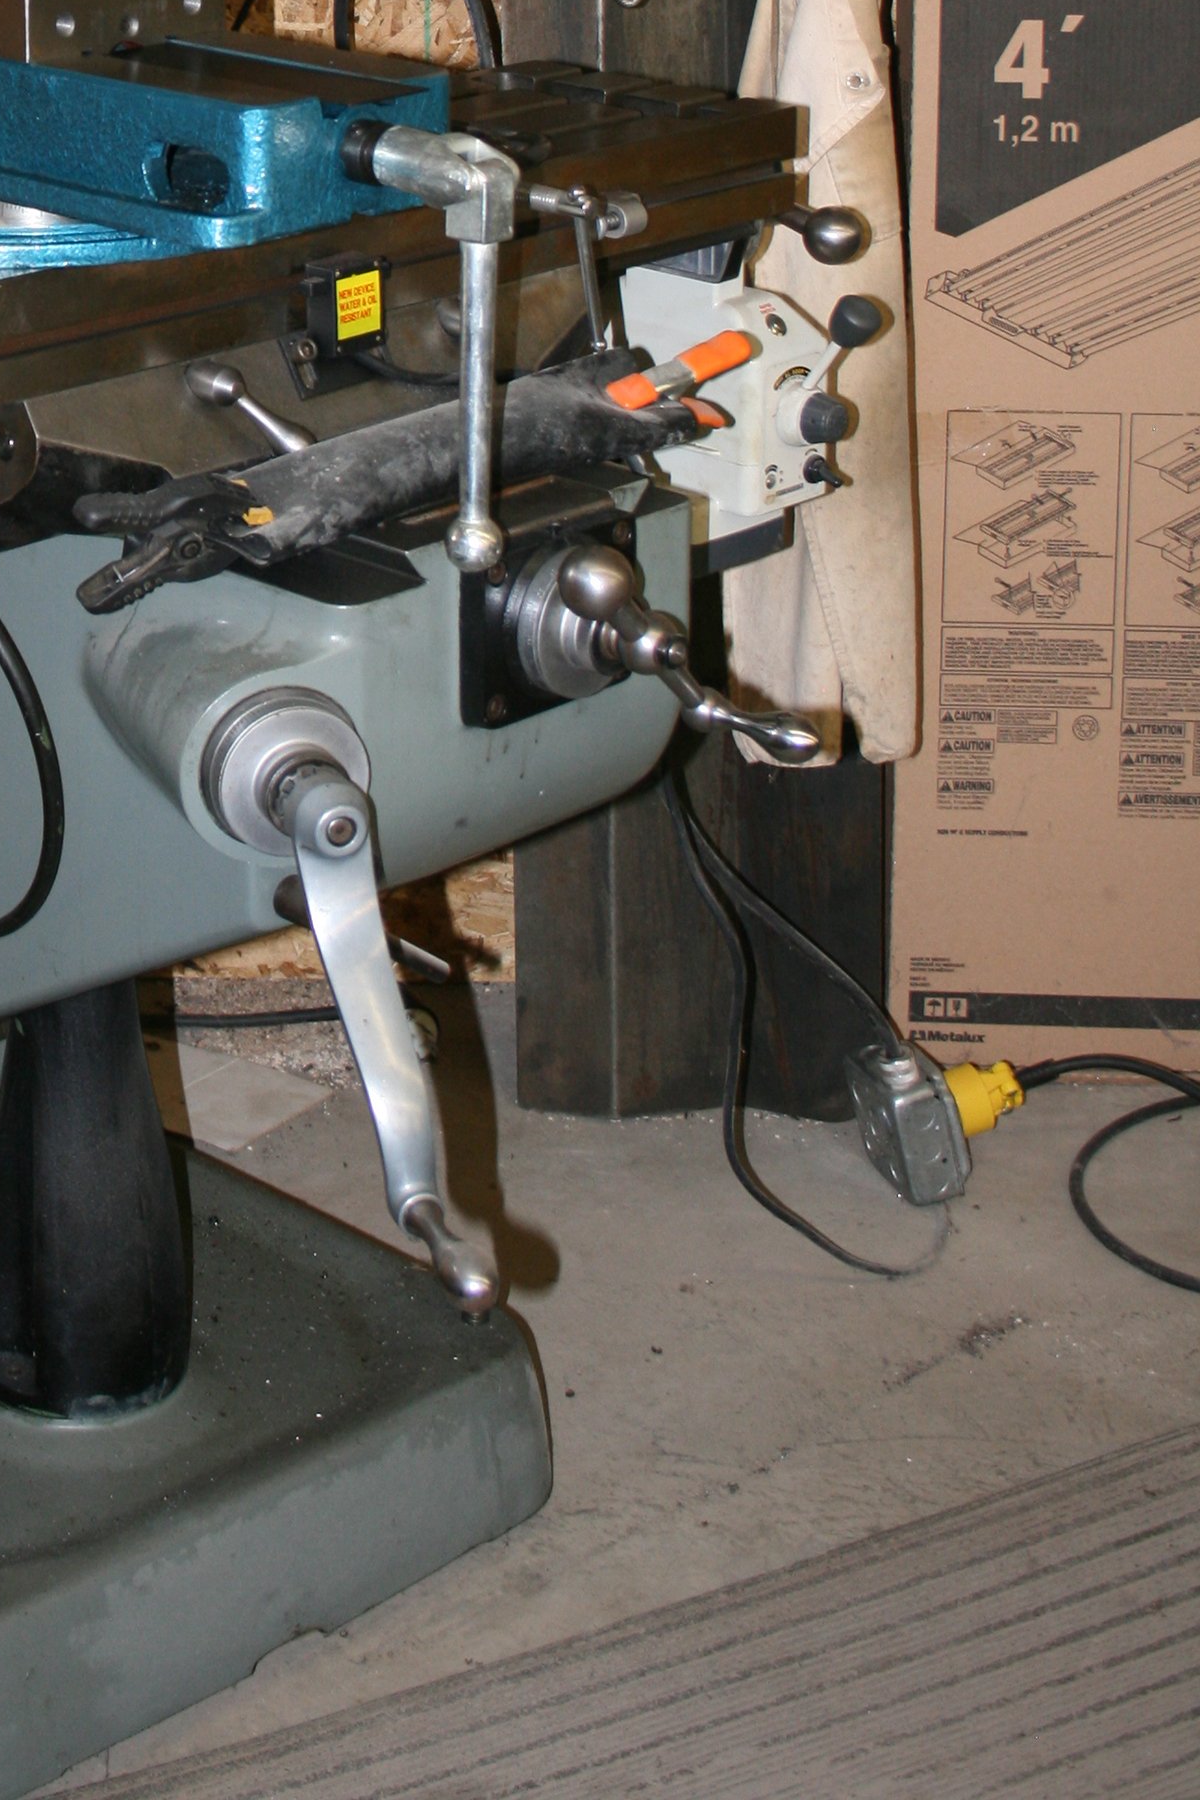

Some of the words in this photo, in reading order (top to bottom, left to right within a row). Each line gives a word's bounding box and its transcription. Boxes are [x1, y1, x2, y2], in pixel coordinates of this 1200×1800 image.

[992, 114, 1039, 148] 1,2
[1050, 119, 1080, 143] m
[339, 288, 353, 299] NEW
[353, 282, 375, 296] DEVICE
[339, 298, 361, 312] WATER
[367, 294, 377, 305] OIL
[339, 307, 372, 323] RESISTANT
[954, 710, 992, 721] CAUTION
[1136, 723, 1183, 736] ATTENTION
[953, 740, 992, 751] CAUTION
[1135, 753, 1182, 765] ATTENTION
[952, 780, 992, 792] WARNING
[927, 1030, 986, 1043] Metalux
